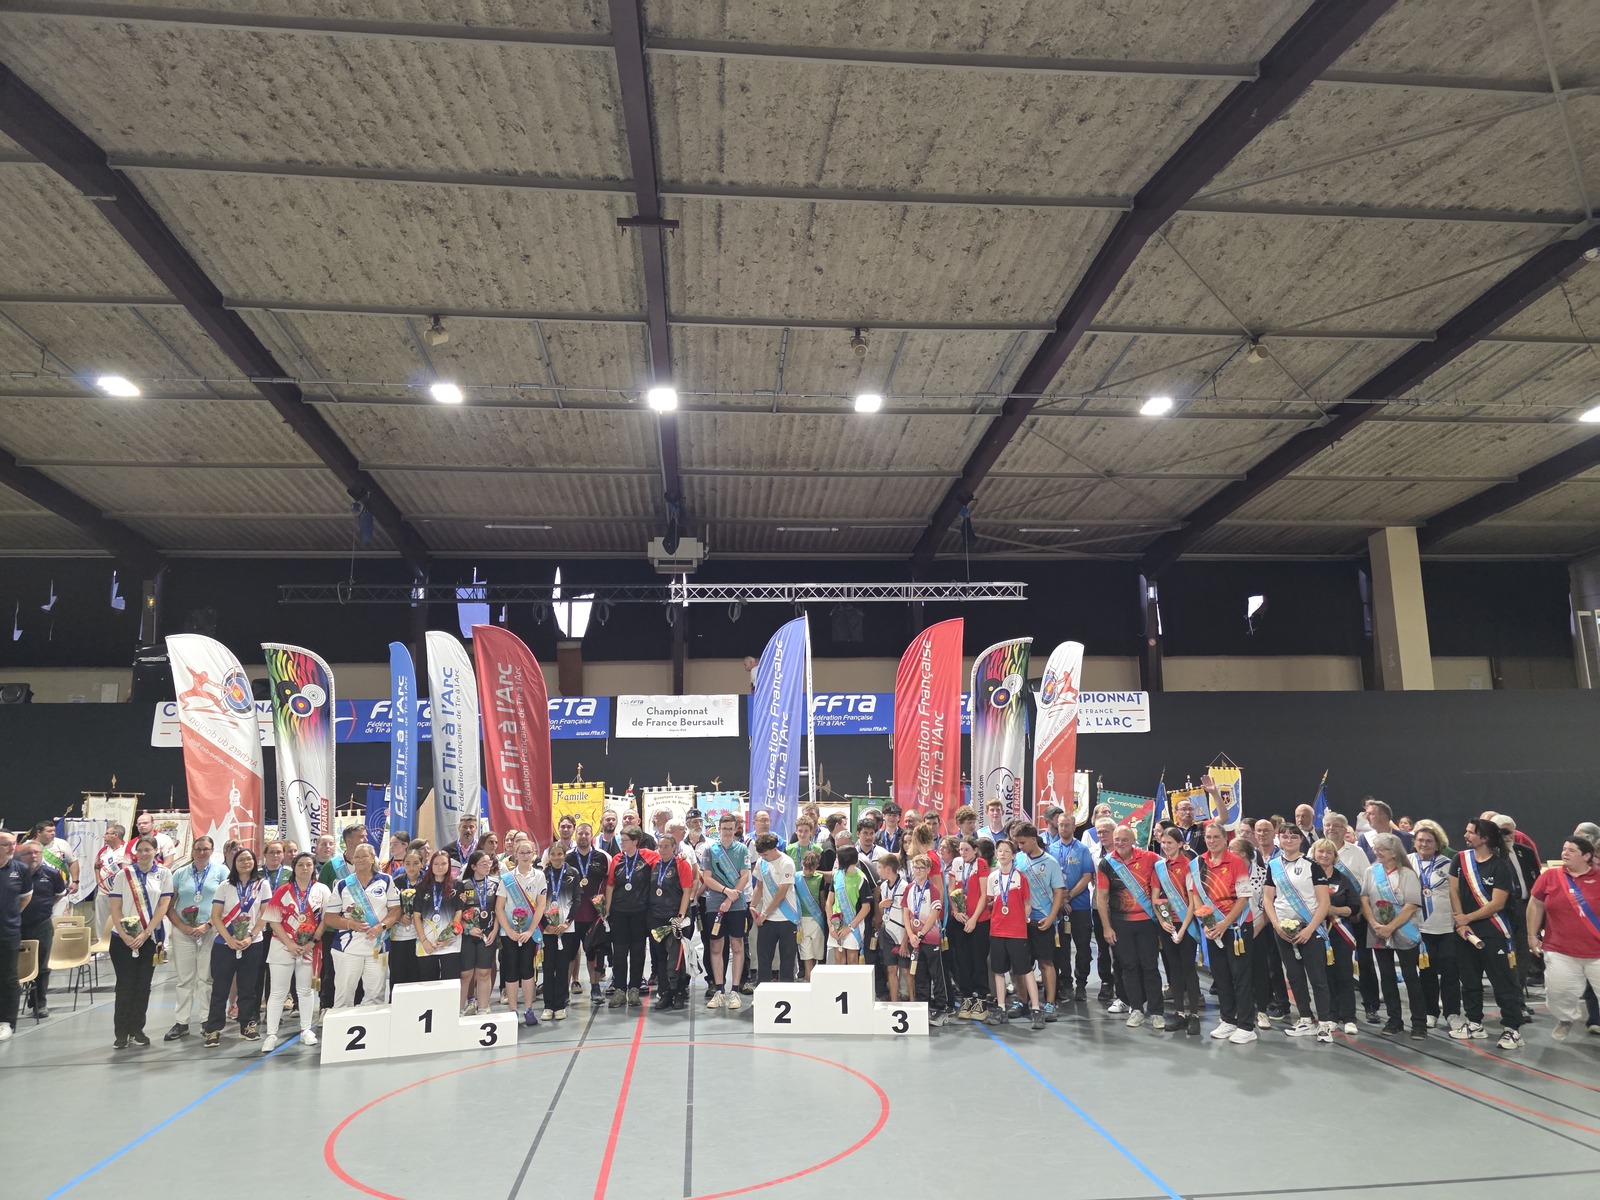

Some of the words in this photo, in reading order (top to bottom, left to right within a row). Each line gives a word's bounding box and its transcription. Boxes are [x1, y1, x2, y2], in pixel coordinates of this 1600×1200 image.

[496, 662, 516, 714] l'Arc
[770, 639, 784, 717] Française
[918, 639, 934, 717] Française
[441, 666, 454, 716] l'Arc
[1078, 692, 1143, 705] PIONNAT
[457, 709, 462, 720] de
[519, 706, 525, 719] de
[560, 718, 592, 726] Française
[631, 718, 643, 727] de
[646, 717, 678, 727] France
[680, 717, 724, 726] Beursault
[646, 706, 708, 717] Championnat
[842, 714, 873, 722] Française
[1086, 717, 1091, 726] À
[1095, 716, 1132, 728] L'ARC
[441, 723, 456, 738] à
[498, 720, 517, 734] à
[778, 711, 789, 746] l'Arc
[931, 710, 945, 747] l'Arc
[456, 721, 464, 764] Française
[518, 718, 529, 763] Française
[396, 749, 405, 776] Tir
[442, 742, 456, 773] Tir
[500, 740, 520, 771] Tir
[764, 717, 779, 810] Fédération
[775, 752, 788, 763] à
[917, 716, 931, 808] Fédération
[932, 749, 945, 762] à
[776, 765, 788, 788] Tir
[931, 763, 945, 785] Tir
[443, 778, 458, 812] FF
[457, 765, 465, 812] Fédération
[502, 777, 524, 812] FF
[520, 763, 532, 812] Fédération
[554, 790, 589, 805] Famille
[279, 780, 287, 840] w.tiralarcidf.com
[776, 791, 786, 814] de
[931, 791, 944, 811] de
[773, 1000, 792, 1024] 2
[835, 991, 849, 1015] 1
[418, 1009, 433, 1034] 1
[891, 1010, 910, 1034] 3
[345, 1025, 367, 1051] 2
[478, 1022, 498, 1047] 3
